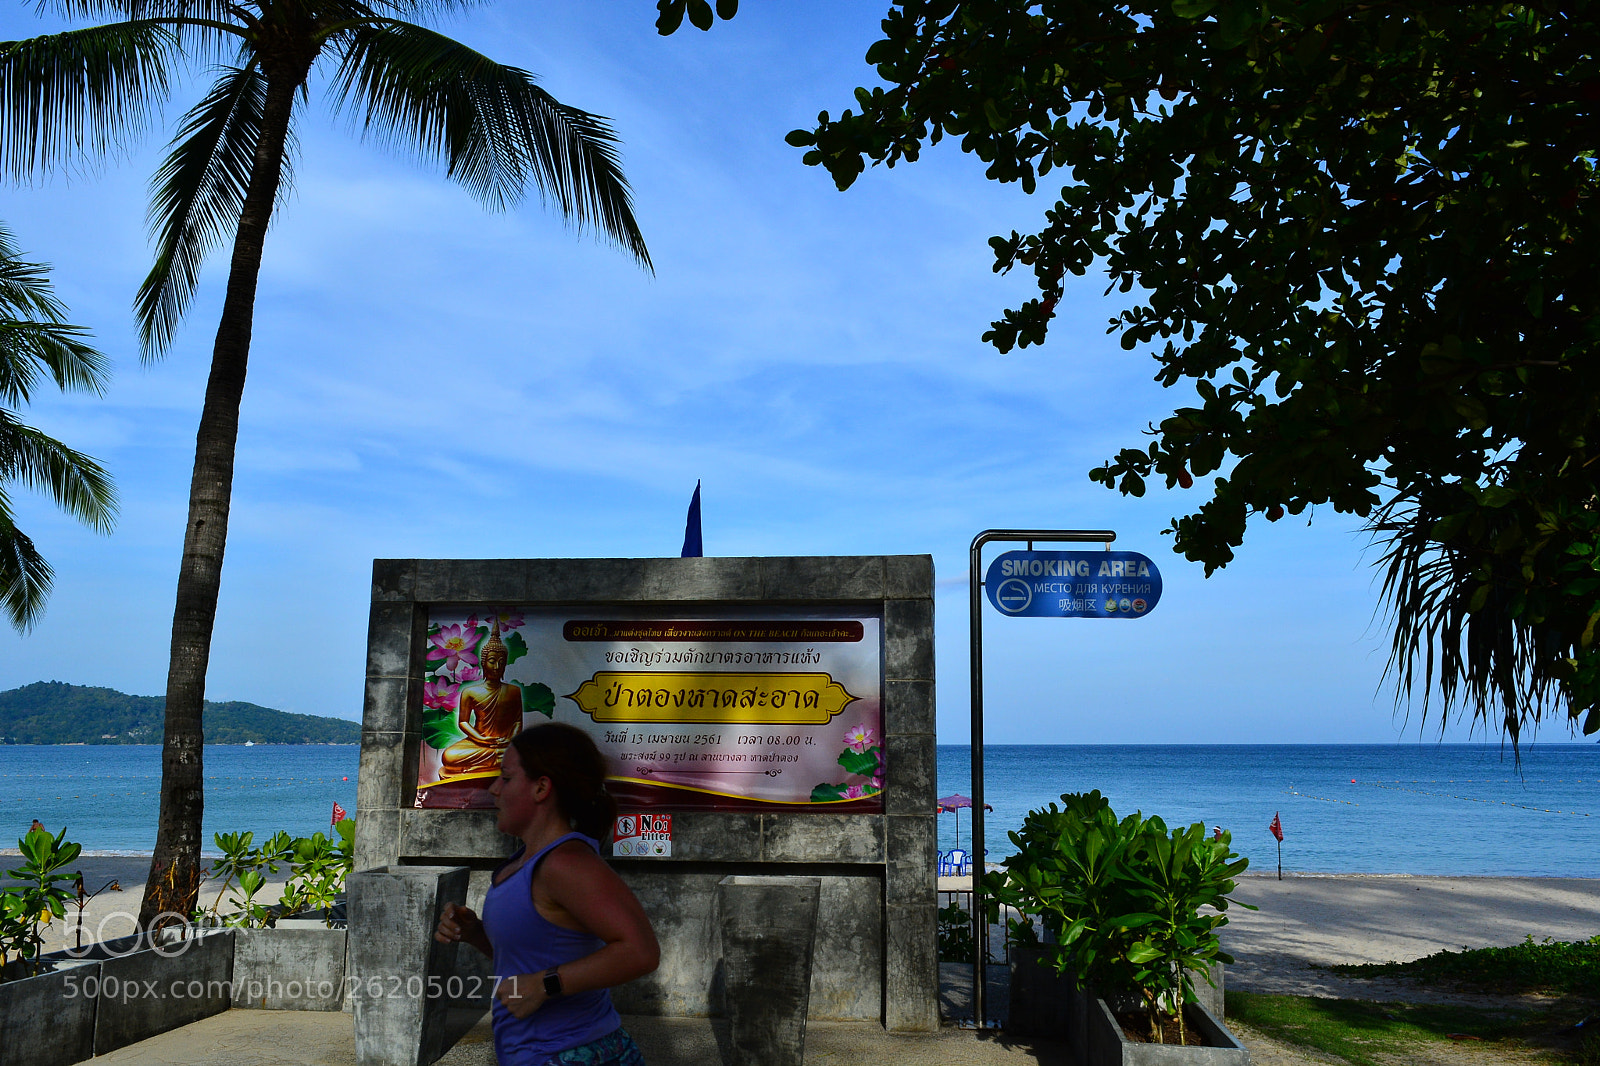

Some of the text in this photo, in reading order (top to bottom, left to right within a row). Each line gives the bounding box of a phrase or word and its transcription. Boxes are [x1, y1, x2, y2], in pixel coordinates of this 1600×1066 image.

[1001, 559, 1151, 578] SMOKING AREA
[1034, 582, 1151, 596] МЕСТО ДЛЯ КУРЕНИЯ
[1058, 598, 1097, 612] 吸烟区
[733, 629, 746, 638] ON
[749, 629, 767, 638] THE
[768, 629, 798, 638] BEACH
[605, 647, 821, 667] ขอเชิญร่วมตักบาตรอาหารแห้ง
[604, 681, 820, 709] ป่าตองหาดสะอาด
[604, 727, 629, 744] วันที่
[630, 733, 644, 744] 13
[647, 733, 690, 744] เมษายน
[693, 733, 722, 745] 2561
[737, 733, 763, 745] เวลา
[766, 734, 801, 746] 08.00
[640, 814, 668, 832] No!
